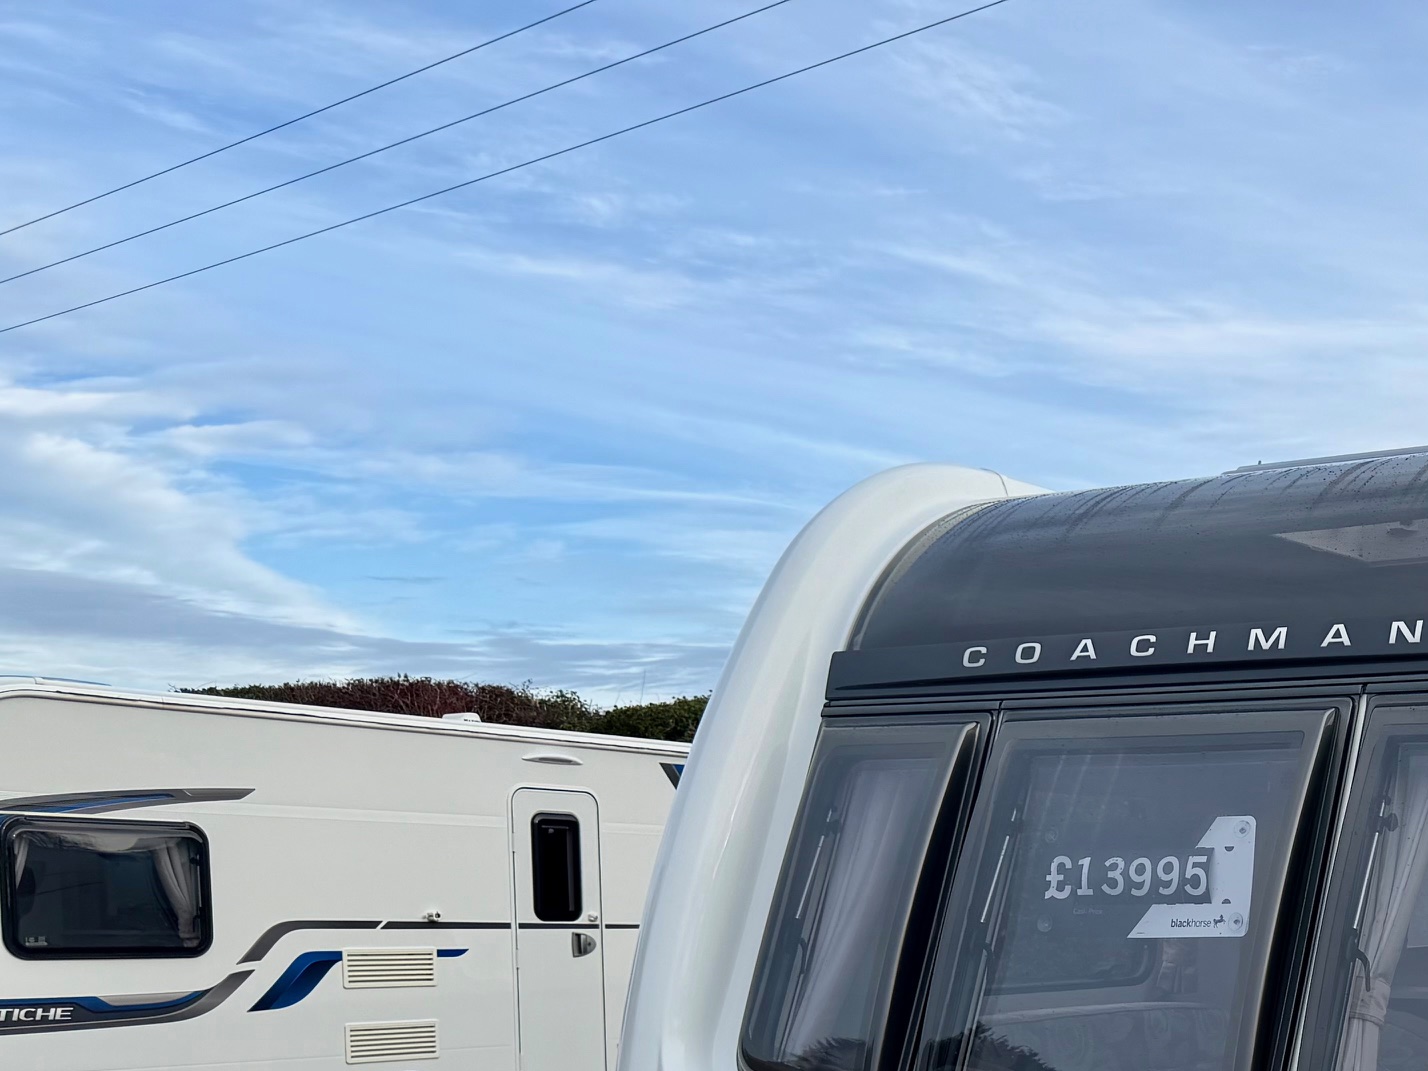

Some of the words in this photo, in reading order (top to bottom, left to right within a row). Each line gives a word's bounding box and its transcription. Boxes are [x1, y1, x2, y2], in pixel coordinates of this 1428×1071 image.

[961, 619, 1424, 668] COACHMAN
[1044, 855, 1208, 900] £13995
[1170, 918, 1212, 929] blackhorse
